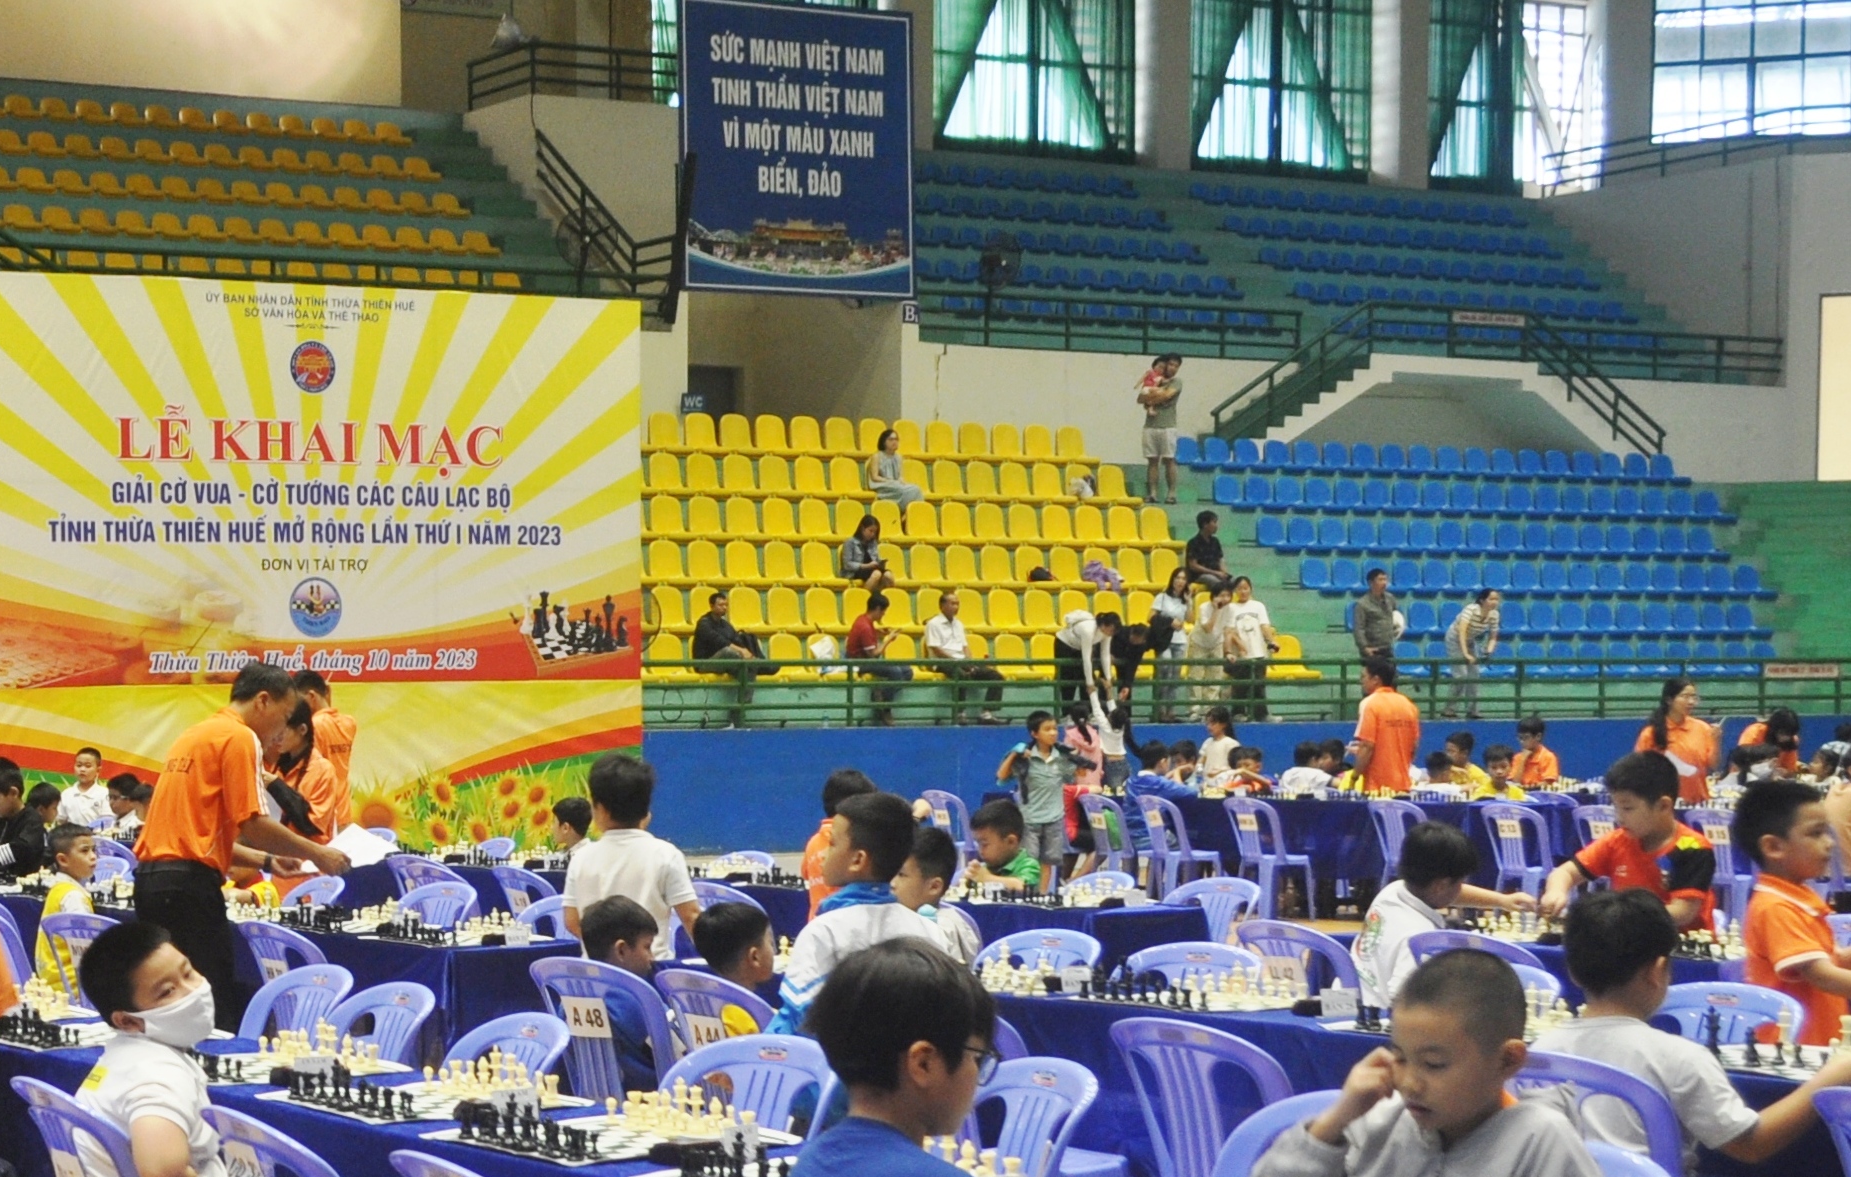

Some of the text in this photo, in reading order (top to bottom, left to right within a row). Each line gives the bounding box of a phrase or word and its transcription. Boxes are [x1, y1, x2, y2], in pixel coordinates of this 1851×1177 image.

[710, 30, 884, 77] SỨC MẠNH VIỆT NAM
[711, 77, 750, 106] TINH
[805, 81, 840, 119] VIỆT
[845, 88, 884, 117] NAM
[723, 115, 874, 158] VÌ MỘT MÀU XANH
[808, 161, 841, 197] ĐẢO
[223, 294, 245, 303] BAN
[248, 293, 278, 305] NHÂN
[280, 293, 302, 306] DÂN
[362, 297, 392, 311] THIÊN
[352, 312, 379, 322] THAO
[684, 396, 703, 408] WC
[116, 404, 505, 479] LỄ KHAI MẠC
[111, 475, 153, 506] GIẢI
[160, 479, 189, 506] CỜ
[194, 483, 231, 506] VUA
[252, 479, 279, 506] CỜ
[285, 479, 349, 507] TƯỚNG
[357, 481, 394, 508] CÁC
[401, 482, 439, 508] CÂU
[445, 486, 480, 513] LẠC
[487, 483, 511, 514] BỘ
[48, 513, 561, 548] TỈNH THỪA THIÊN HUẾ MỞ RỘNG LẦN THỨ I NĂM 2023
[261, 558, 369, 574] ĐƠN VỊ TÀI TRỢ
[150, 651, 199, 673] Thừa
[310, 649, 362, 674] tháng
[367, 650, 388, 671] 10
[393, 650, 432, 671] năm
[435, 649, 477, 671] 2023
[572, 1006, 604, 1028] A 48
[694, 1024, 703, 1045] A
